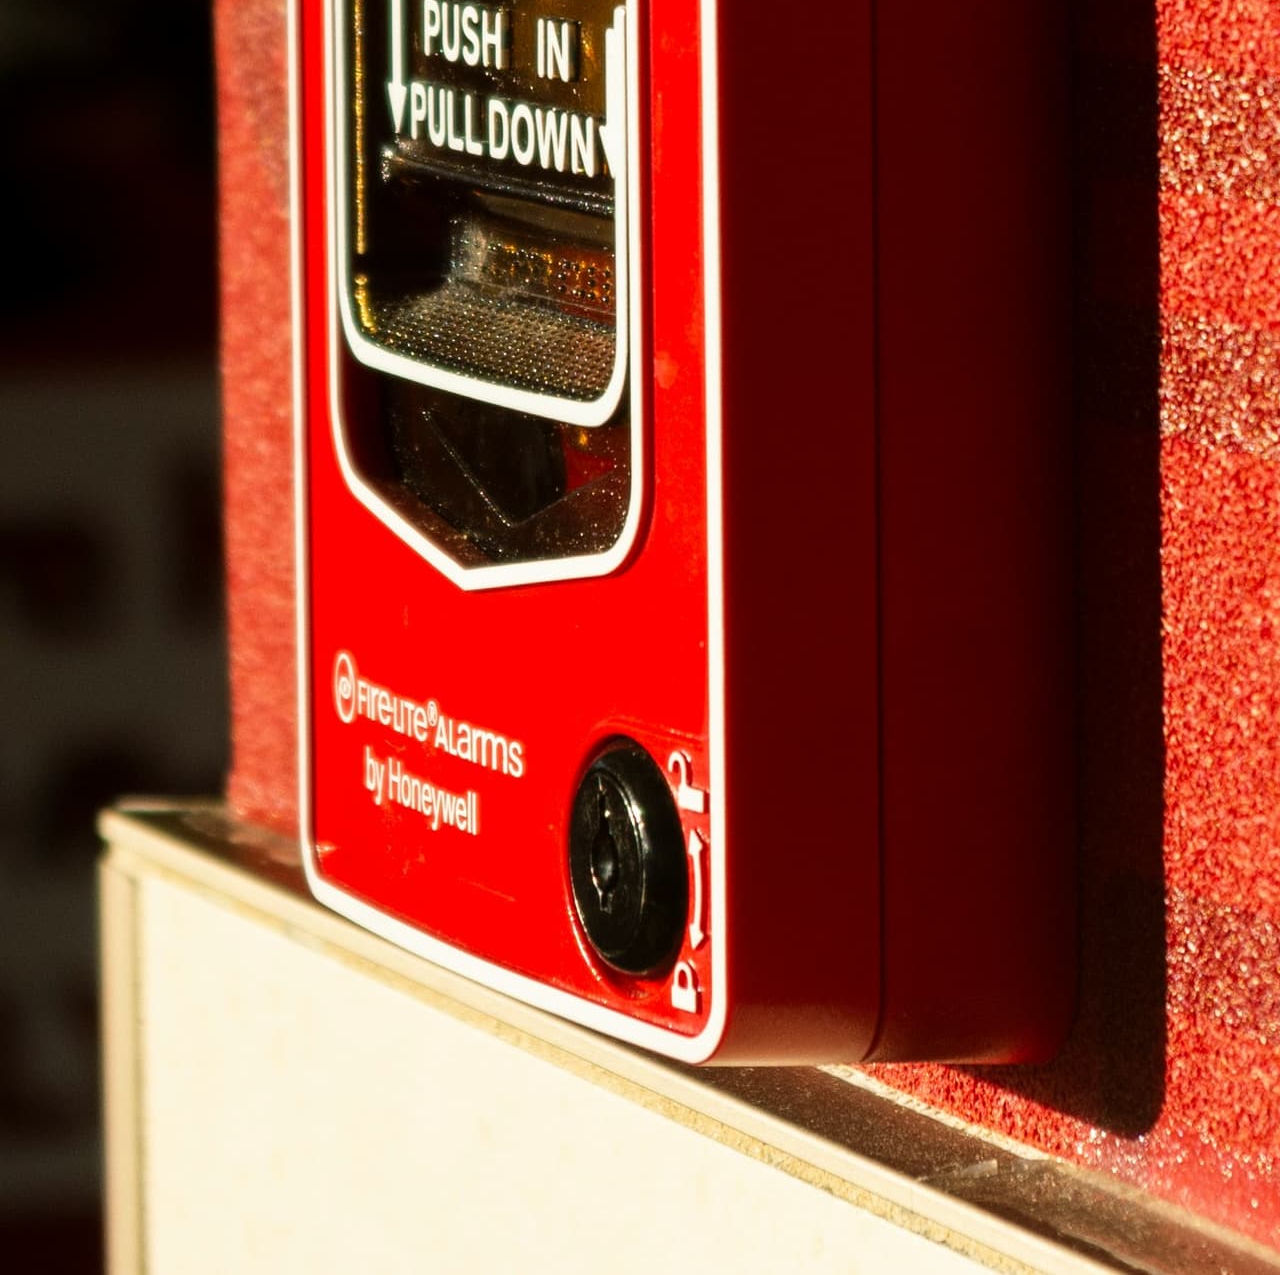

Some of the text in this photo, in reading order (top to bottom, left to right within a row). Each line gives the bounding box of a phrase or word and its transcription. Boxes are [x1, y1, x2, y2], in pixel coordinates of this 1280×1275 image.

[536, 17, 570, 83] IN
[410, 83, 595, 179] PULL DOWN
[364, 745, 478, 836] by Honeywell
